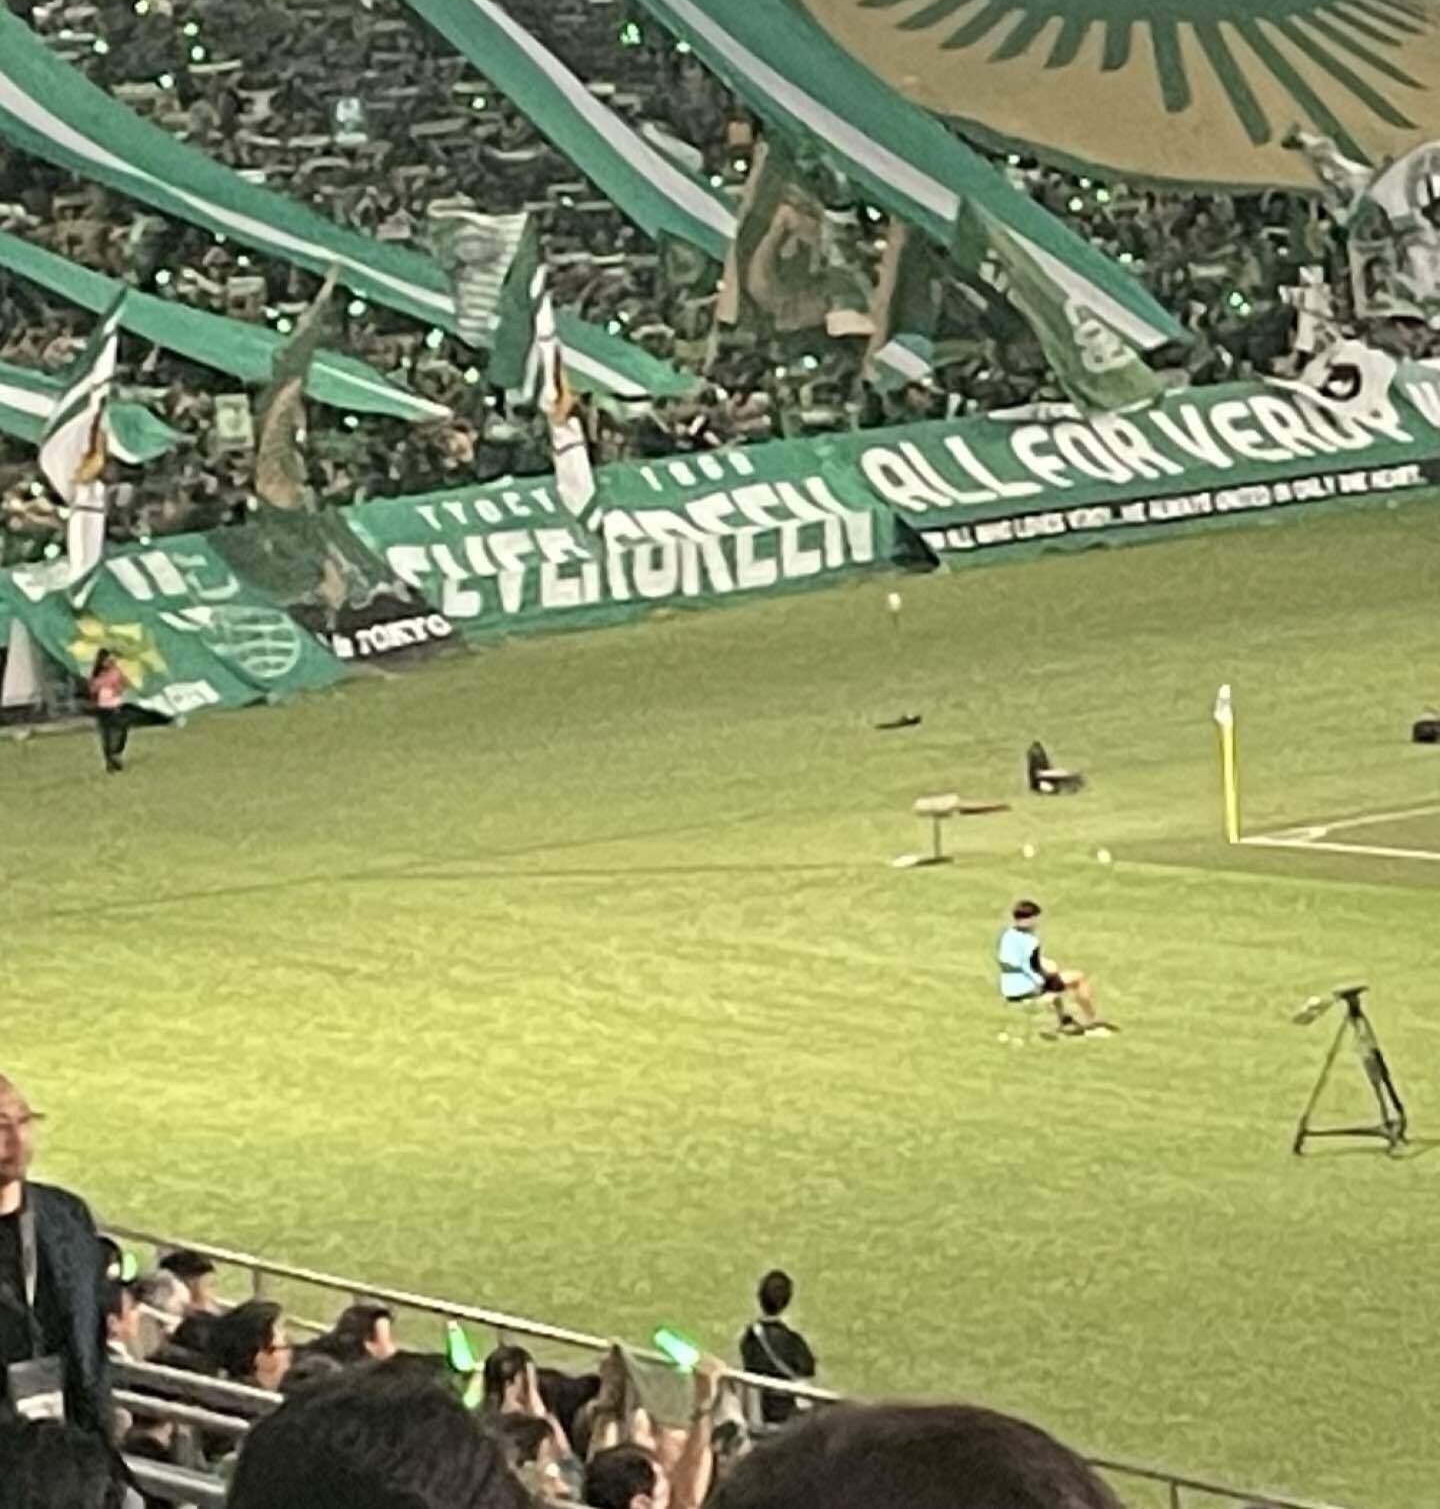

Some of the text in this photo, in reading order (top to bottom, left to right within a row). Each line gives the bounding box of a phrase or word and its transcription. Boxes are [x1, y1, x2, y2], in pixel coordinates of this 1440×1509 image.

[859, 434, 1044, 512] ALL
[1008, 400, 1186, 489] FOR
[385, 476, 877, 619] EVERGREEN
